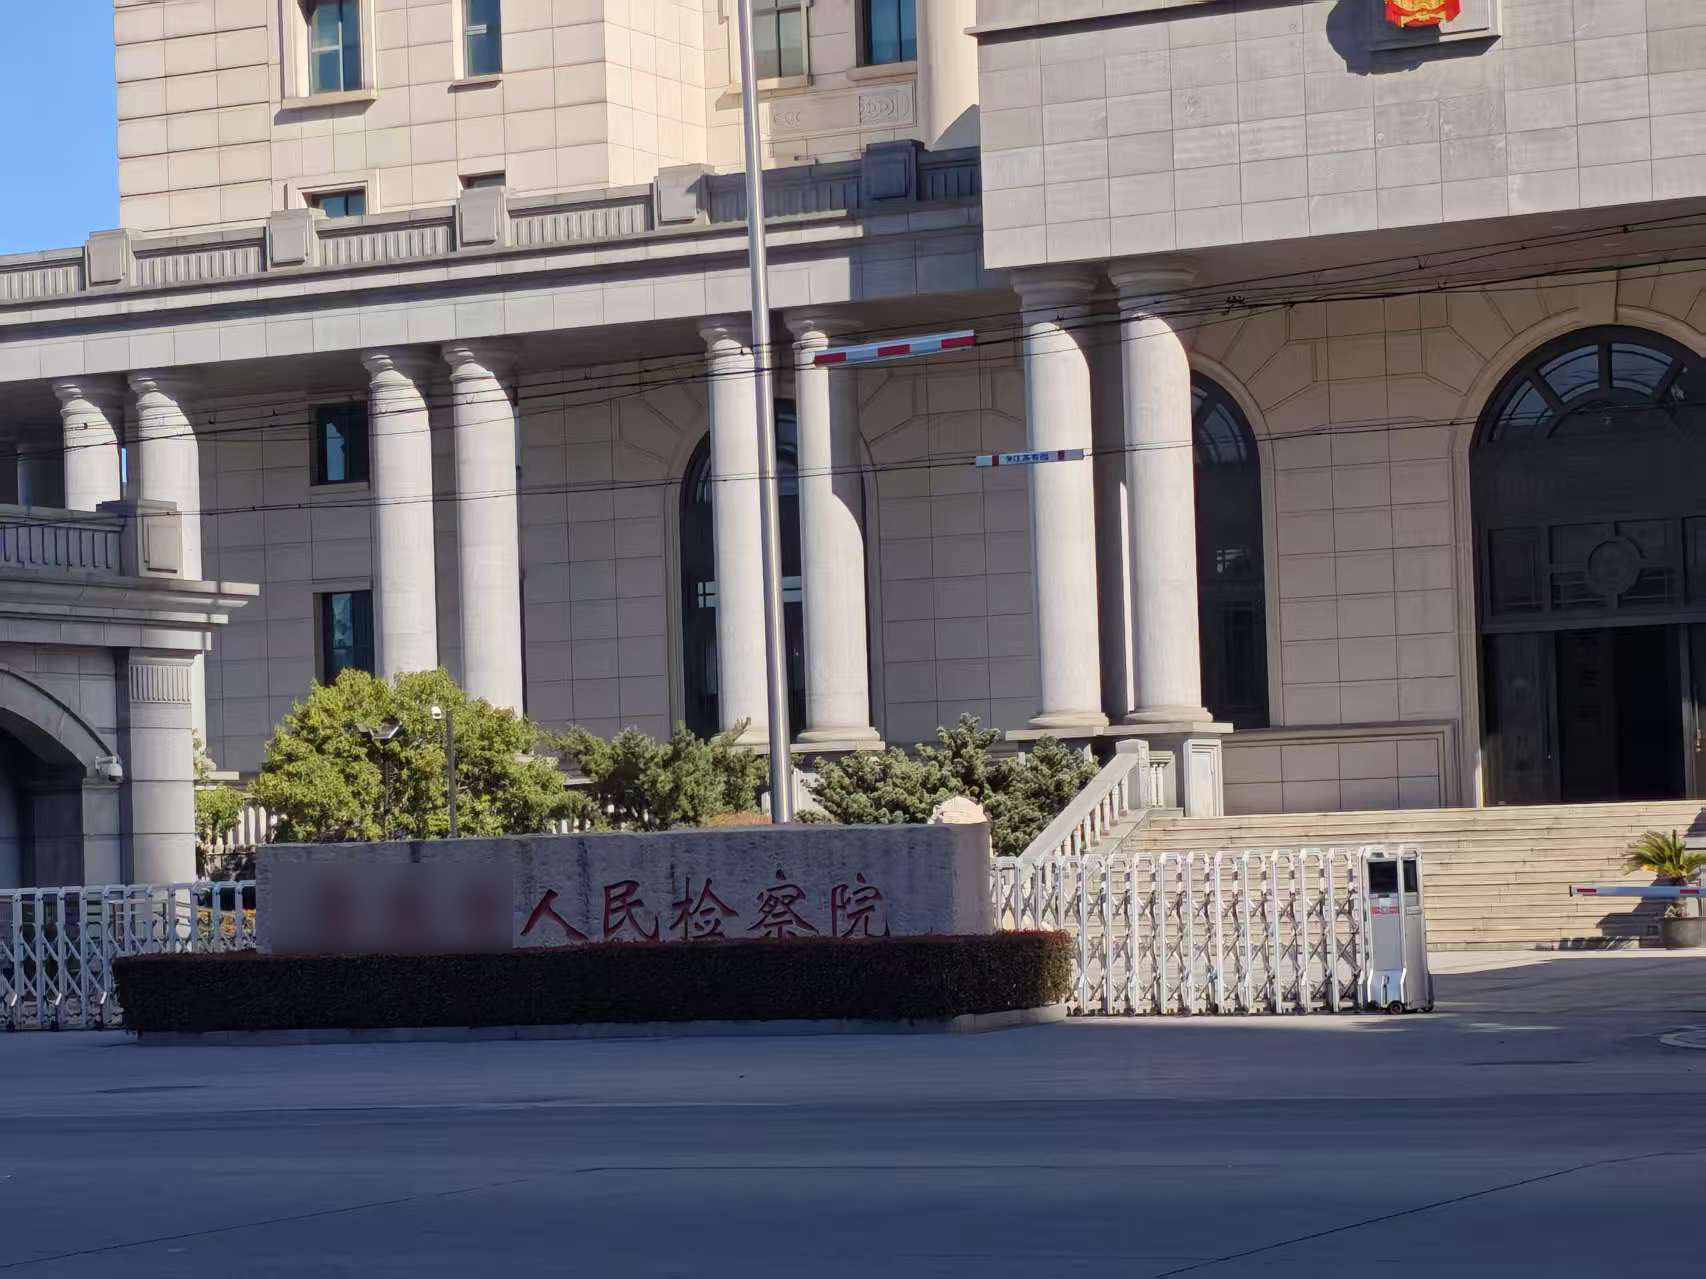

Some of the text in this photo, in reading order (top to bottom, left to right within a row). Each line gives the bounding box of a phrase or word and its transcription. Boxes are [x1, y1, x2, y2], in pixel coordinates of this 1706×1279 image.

[520, 869, 890, 940] 人民检察院
